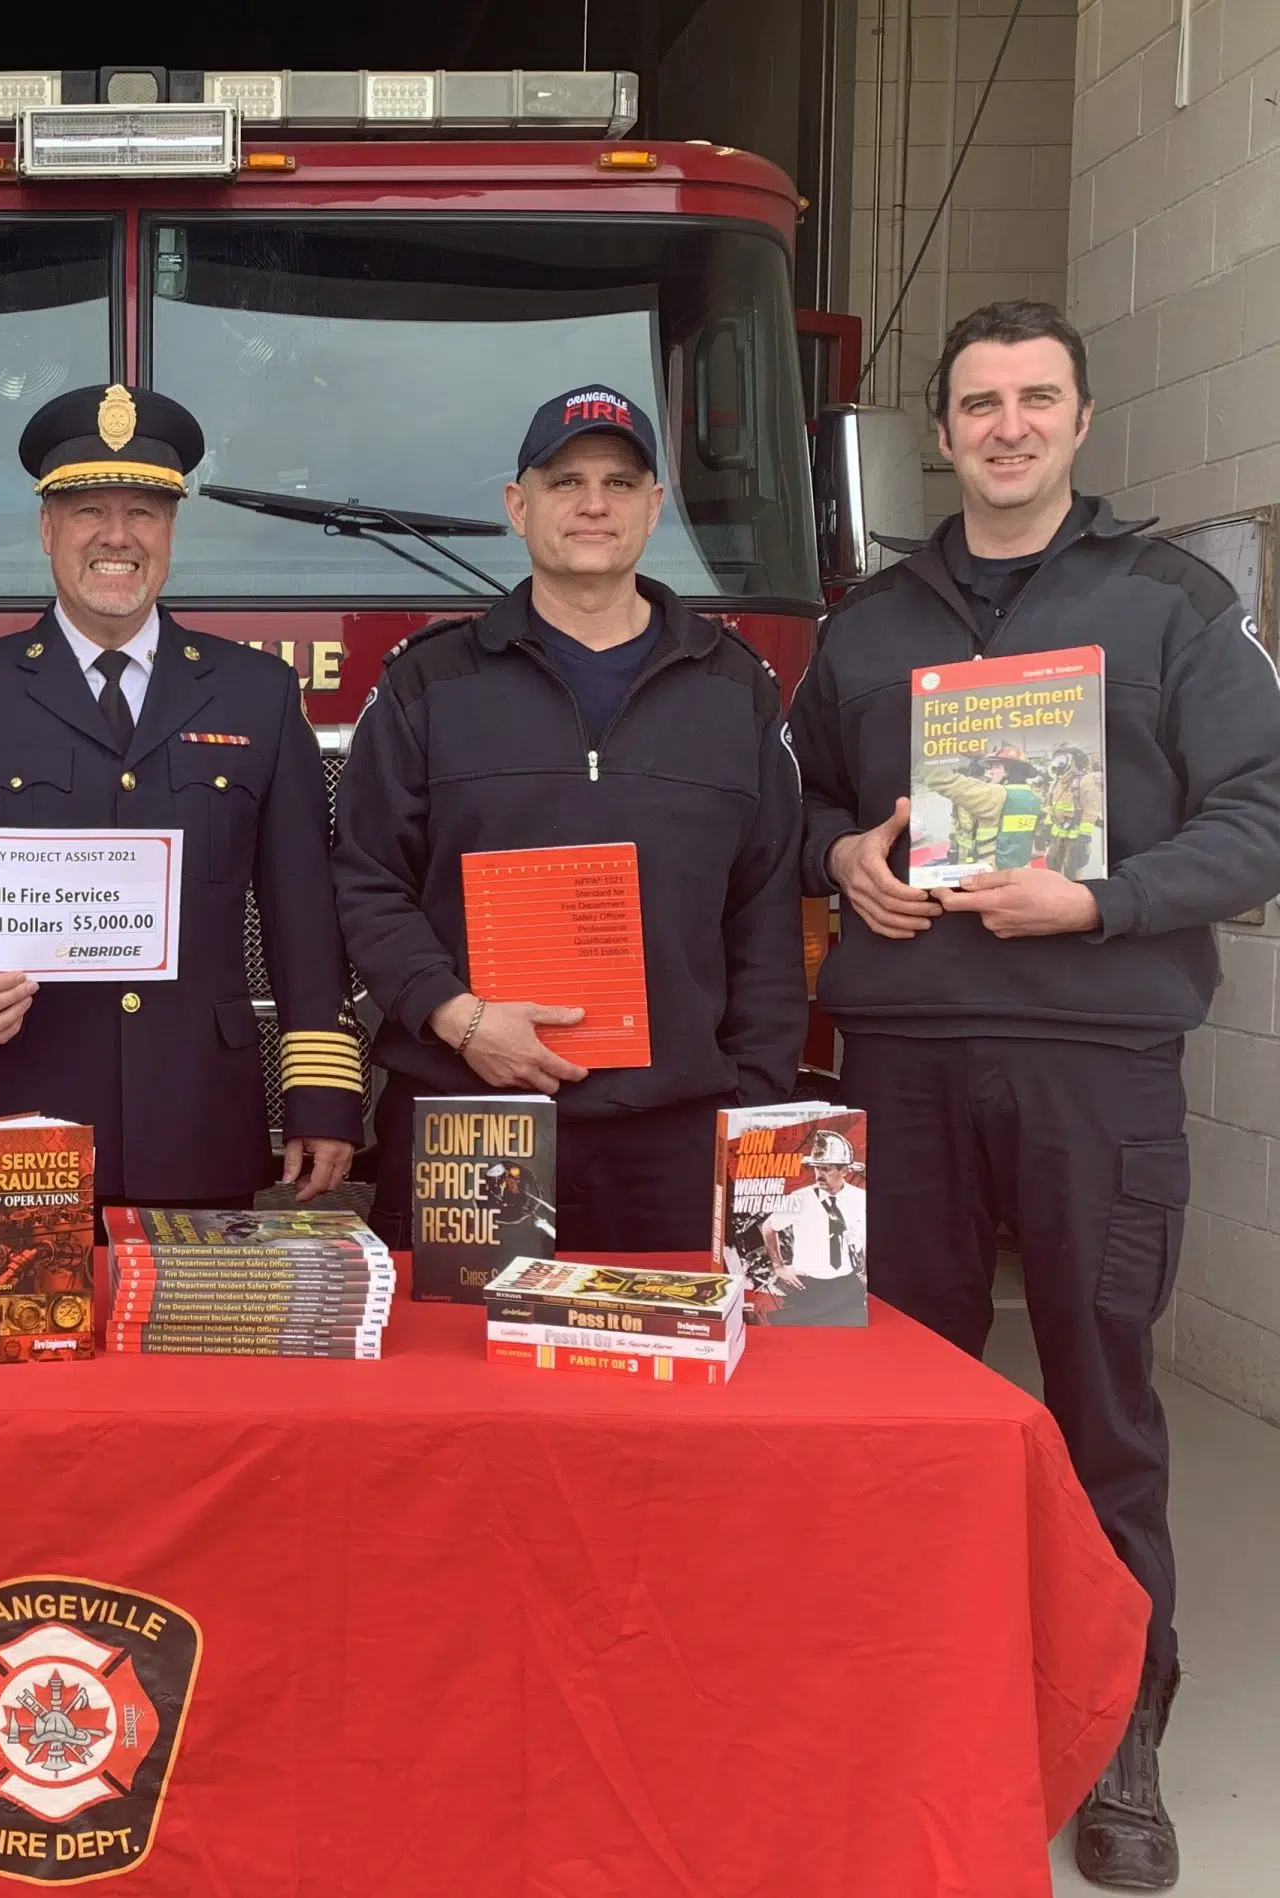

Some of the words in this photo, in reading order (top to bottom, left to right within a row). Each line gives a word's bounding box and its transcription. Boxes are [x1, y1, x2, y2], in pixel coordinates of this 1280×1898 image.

[567, 392, 628, 410] ORANGEVILLE
[563, 401, 634, 431] FIRE
[924, 701, 960, 719] Fire
[965, 685, 1084, 713] Department
[924, 715, 1003, 738] Incident
[1008, 708, 1075, 728] Safety
[923, 737, 988, 758] Officer
[10, 851, 62, 862] PROJECT
[65, 851, 104, 862] ASSIST
[108, 851, 136, 861] 2021
[21, 888, 51, 903] Fire
[55, 887, 120, 903] Services
[8, 918, 63, 933] Dollars
[73, 914, 154, 932] $5,000.00
[69, 946, 142, 957] ENBRIDGE
[424, 1113, 534, 1157] CONFINED
[736, 1130, 776, 1154] JOHN
[1, 1151, 80, 1170] SERVICE
[736, 1153, 803, 1178] NORMAN
[415, 1162, 489, 1201] SPACE
[734, 1178, 786, 1196] WORKING
[4, 1193, 79, 1207] OPERATIONS
[733, 1195, 762, 1213] WITH
[762, 1195, 802, 1213] GIANTS
[422, 1207, 501, 1245] RESCUE
[180, 1271, 218, 1279] Department
[460, 1266, 489, 1287] CHASE
[177, 1282, 216, 1290] Department
[568, 1309, 605, 1329] Pass
[621, 1314, 643, 1332] On
[163, 1335, 202, 1343] Department
[545, 1329, 578, 1345] Pass
[570, 1355, 597, 1368] PASS
[599, 1356, 609, 1368] IT
[612, 1359, 626, 1370] ON
[627, 1359, 639, 1373] 3
[56, 1827, 140, 1861] DEPT.
